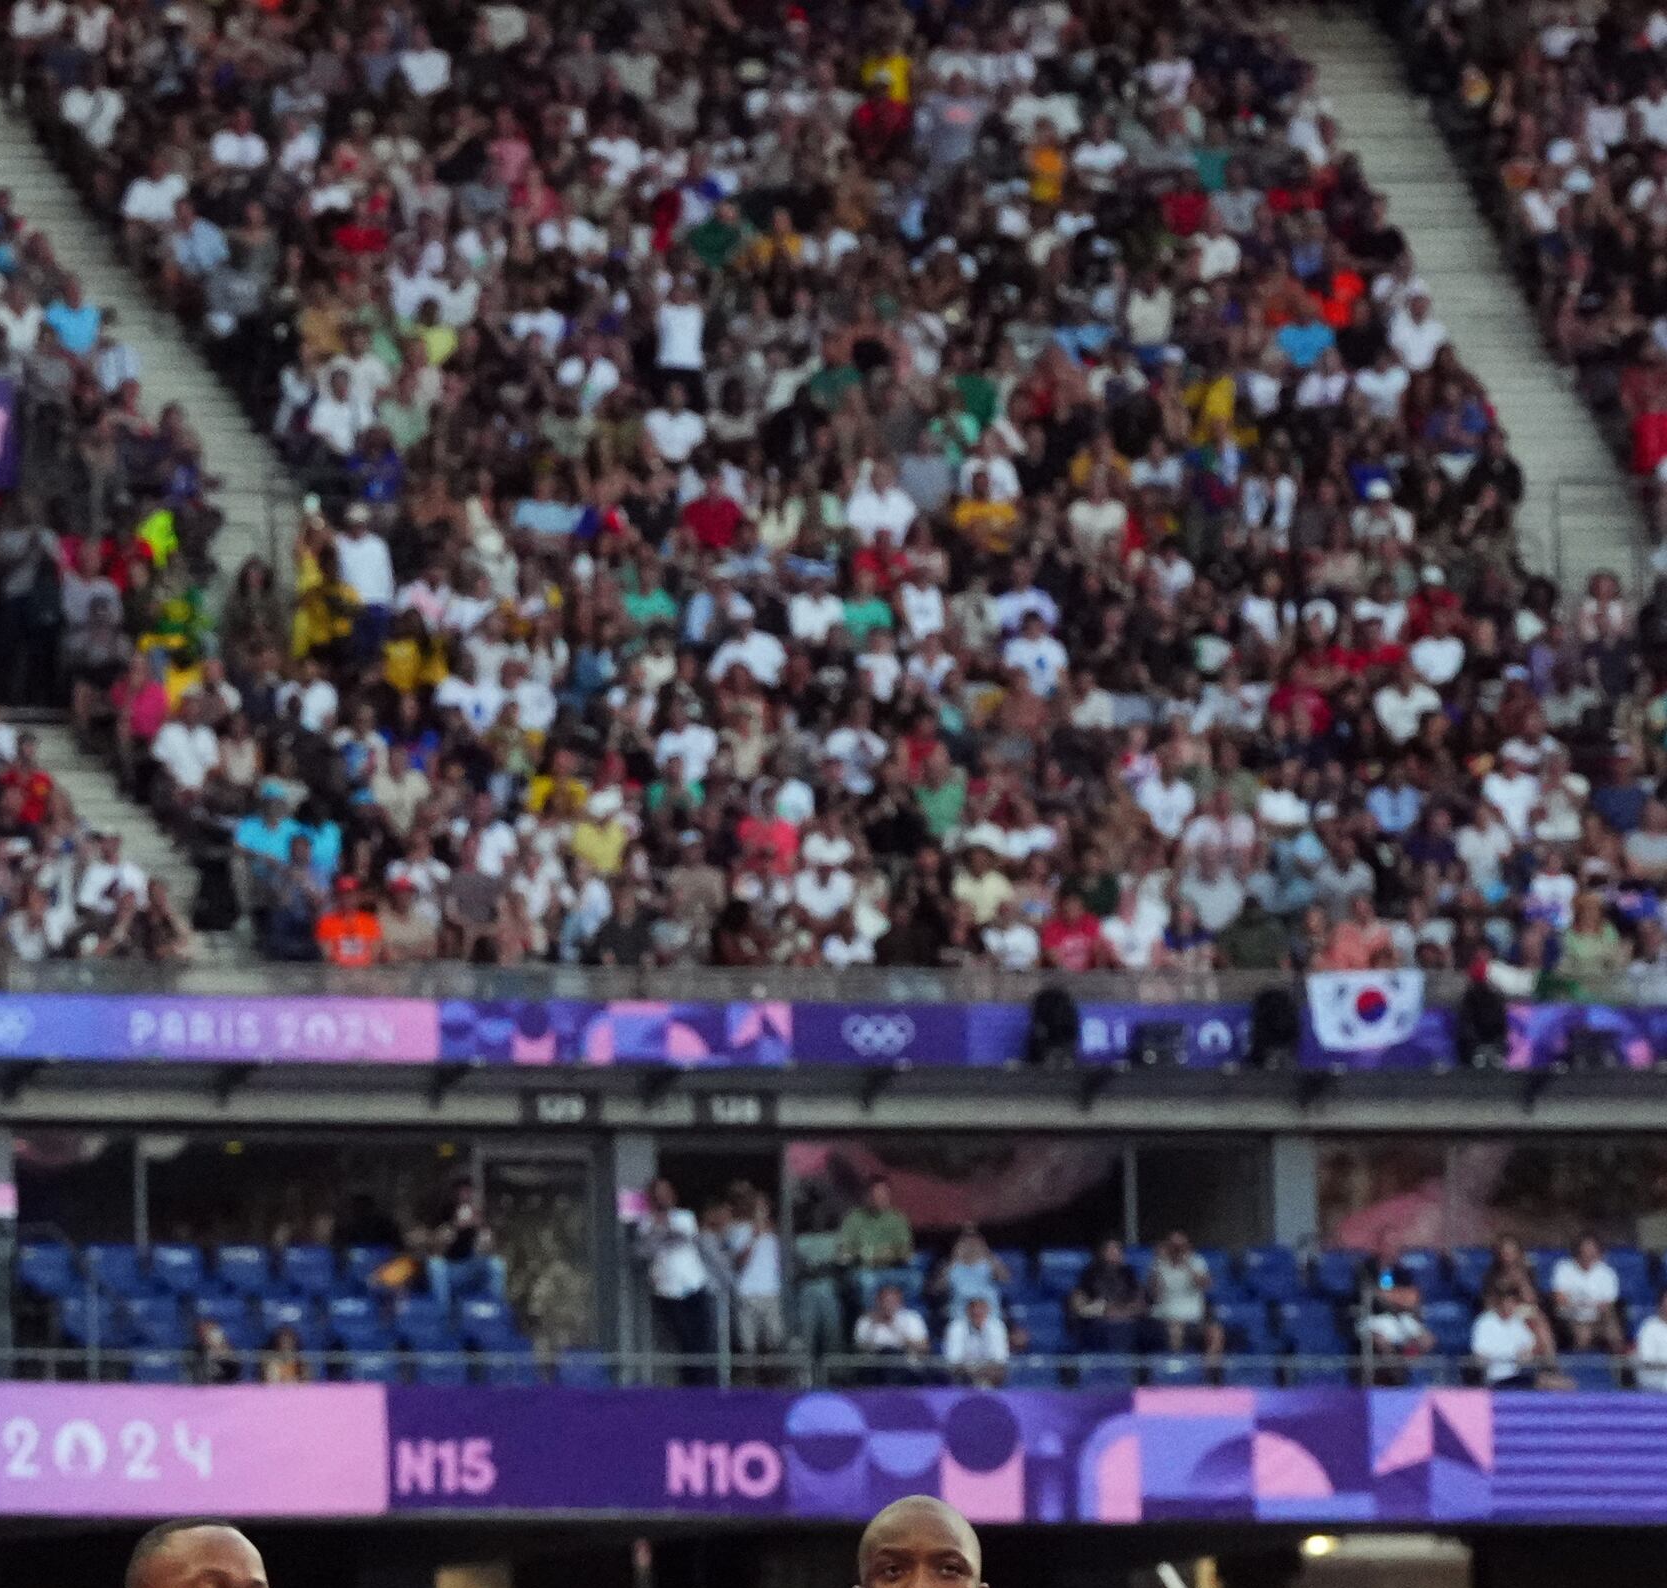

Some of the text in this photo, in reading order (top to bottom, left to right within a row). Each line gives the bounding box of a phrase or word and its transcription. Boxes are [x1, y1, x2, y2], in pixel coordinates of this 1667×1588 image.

[129, 1009, 394, 1049] PARIS 2024
[2, 1418, 213, 1481] 2024
[395, 1438, 497, 1496] N15
[667, 1440, 782, 1499] N10
